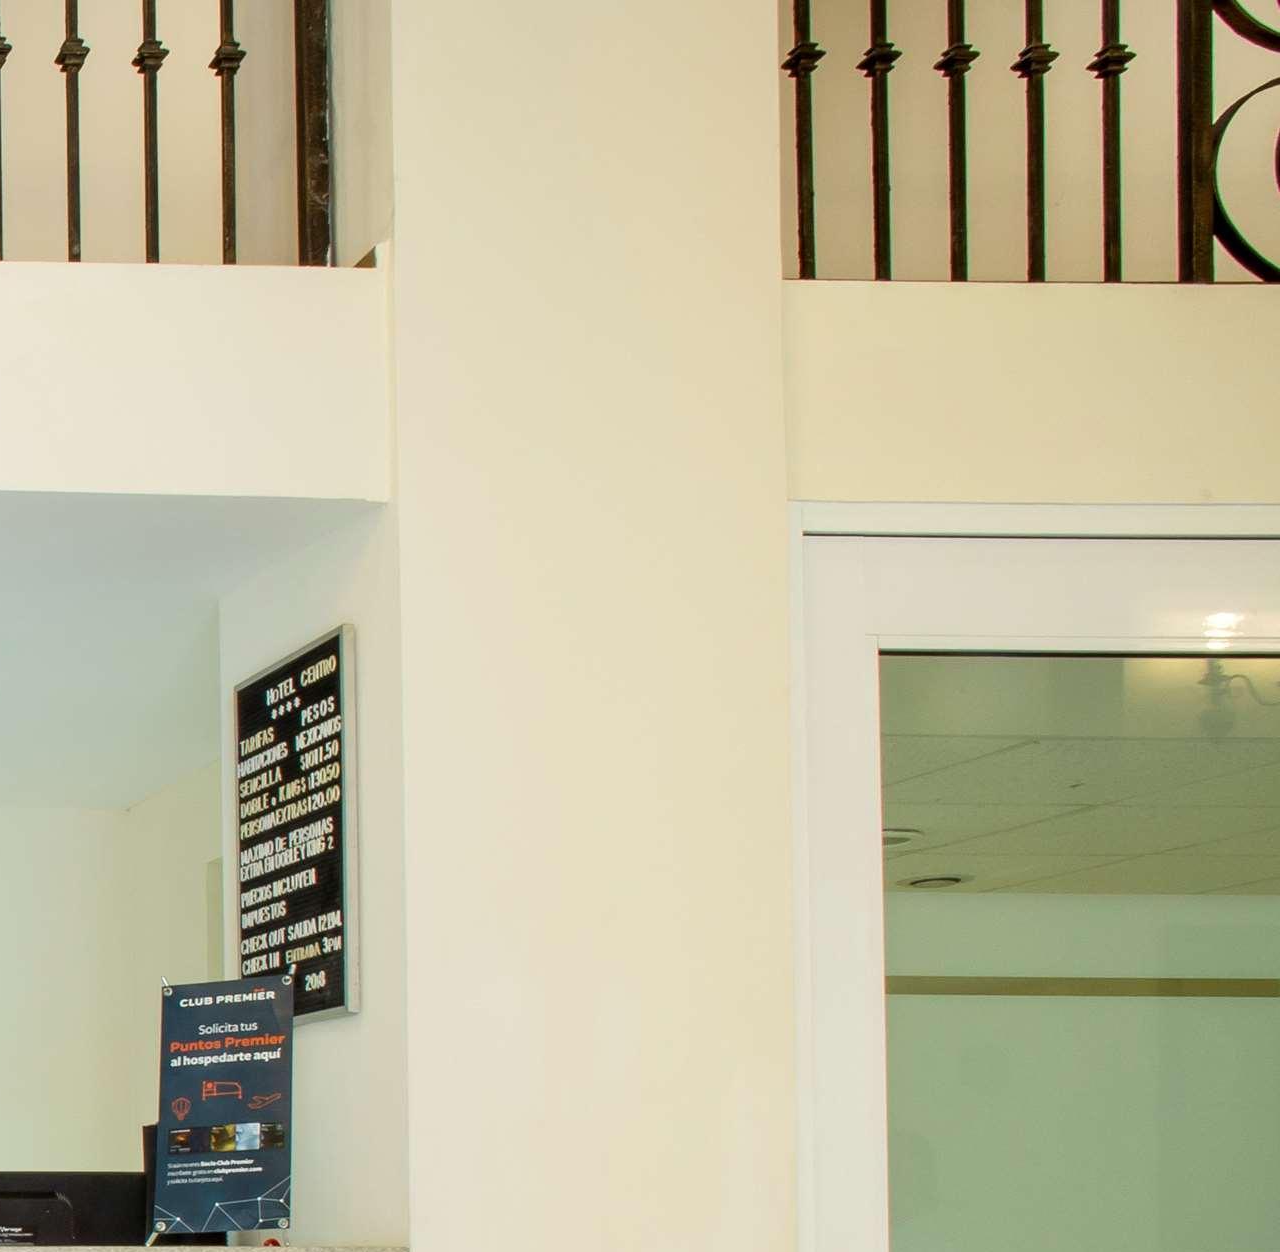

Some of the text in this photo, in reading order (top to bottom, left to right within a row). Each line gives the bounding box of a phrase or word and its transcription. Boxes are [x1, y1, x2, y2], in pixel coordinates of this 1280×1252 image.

[300, 655, 337, 687] CENTRO
[240, 696, 335, 756] TARIFAS PESOS
[295, 715, 341, 752] MEXICANOS
[240, 766, 282, 798] SENCILLA
[241, 793, 269, 819] DOBLE
[241, 816, 334, 866] MAXIMO DE PERSONAS
[327, 836, 334, 850] 2
[241, 867, 316, 908] PRECIOS INCLUYEN
[241, 900, 286, 929] IMPUESTOS
[241, 933, 268, 955] CHECK
[269, 927, 285, 947] OUT
[287, 918, 317, 942] SALIDA
[242, 954, 268, 976] CHECK
[269, 951, 280, 969] IN
[286, 942, 321, 964] ENTRADA
[179, 990, 276, 1008] CLUB PREMIER
[170, 1034, 285, 1053] Puntos Premier
[198, 1022, 258, 1035] Solicita tus
[170, 1048, 282, 1067] al hospedarte aquí
